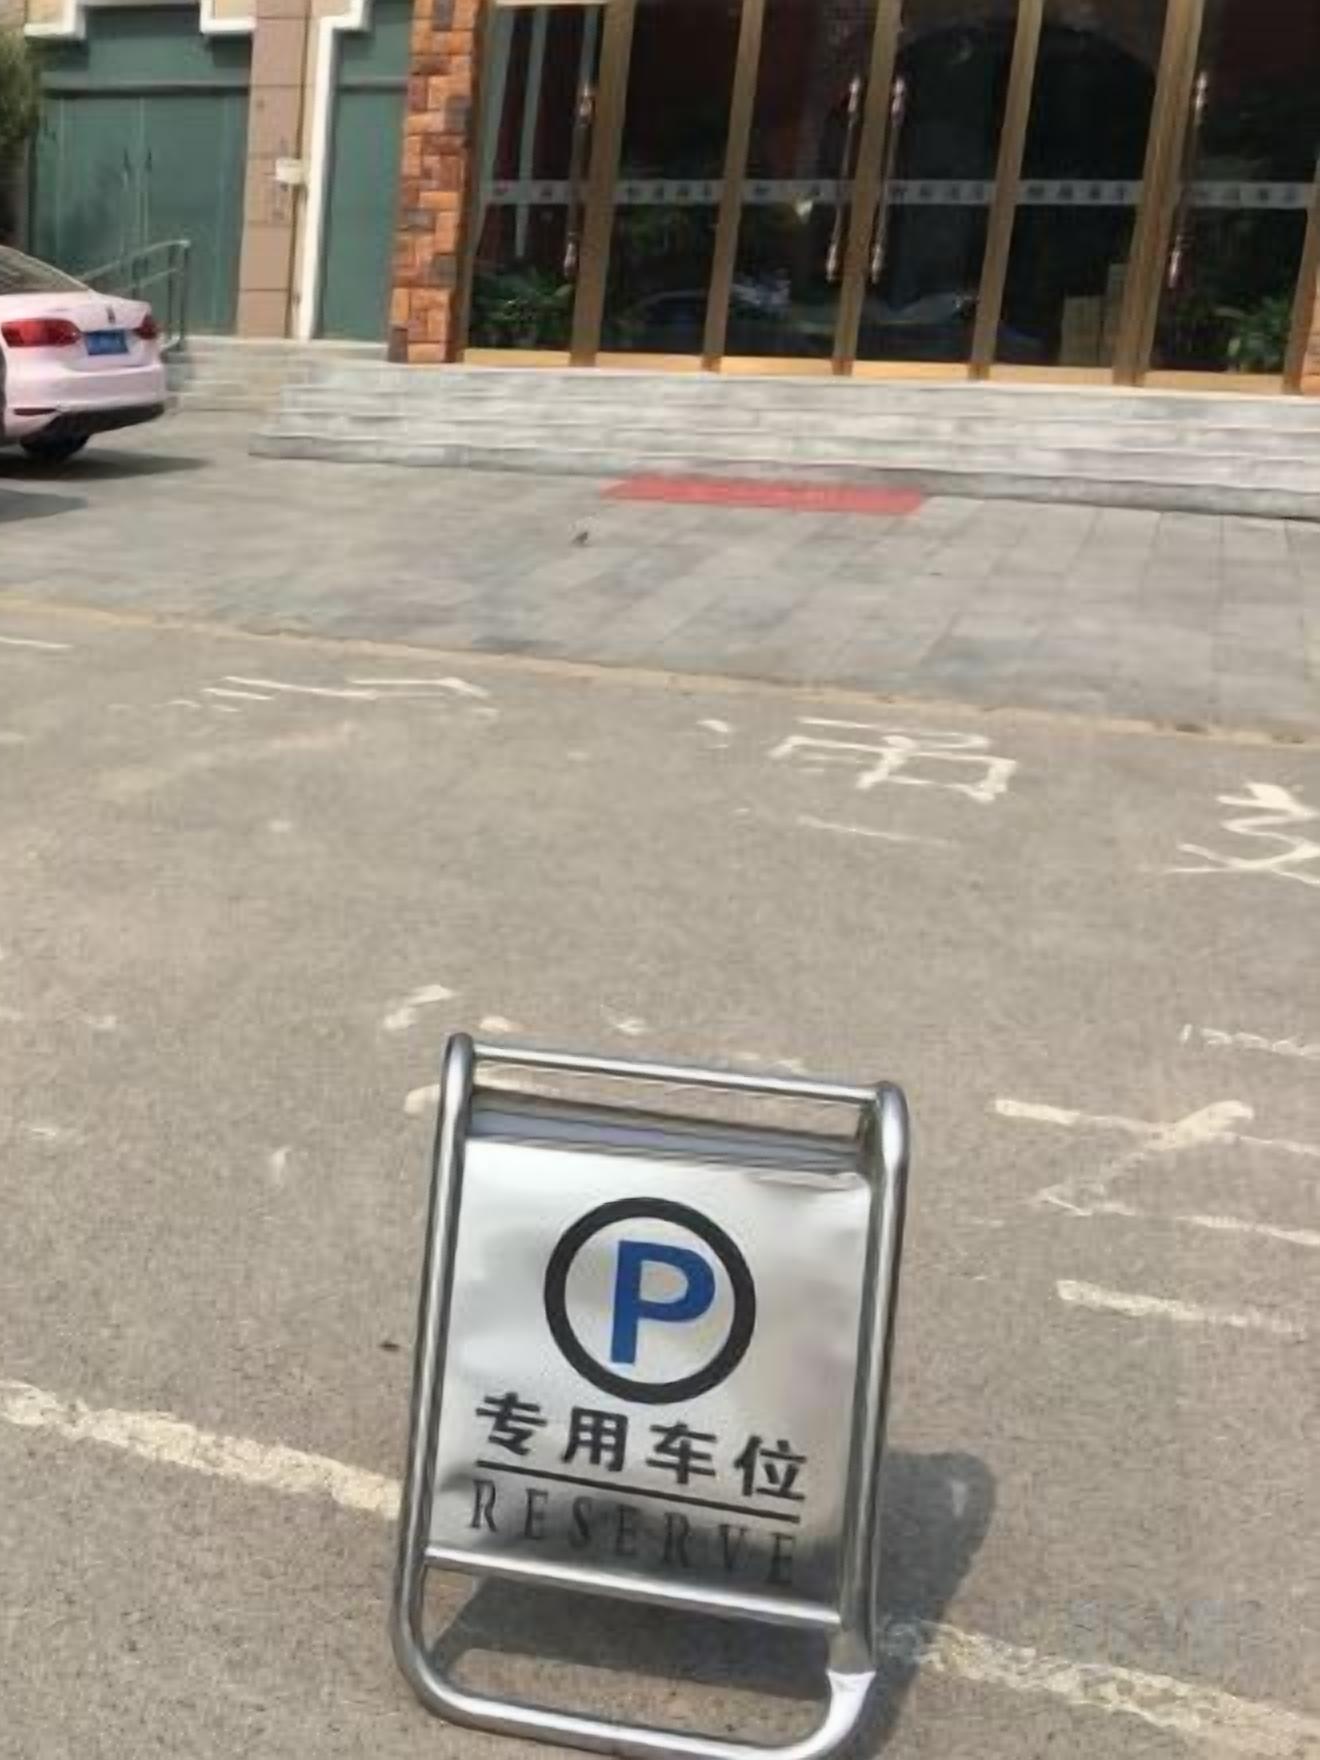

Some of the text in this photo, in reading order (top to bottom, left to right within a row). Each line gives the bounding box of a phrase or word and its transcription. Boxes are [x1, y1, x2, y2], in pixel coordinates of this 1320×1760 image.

[610, 1239, 716, 1364] P
[475, 1391, 807, 1501] 专用车位
[468, 1478, 797, 1585] RESERVE
